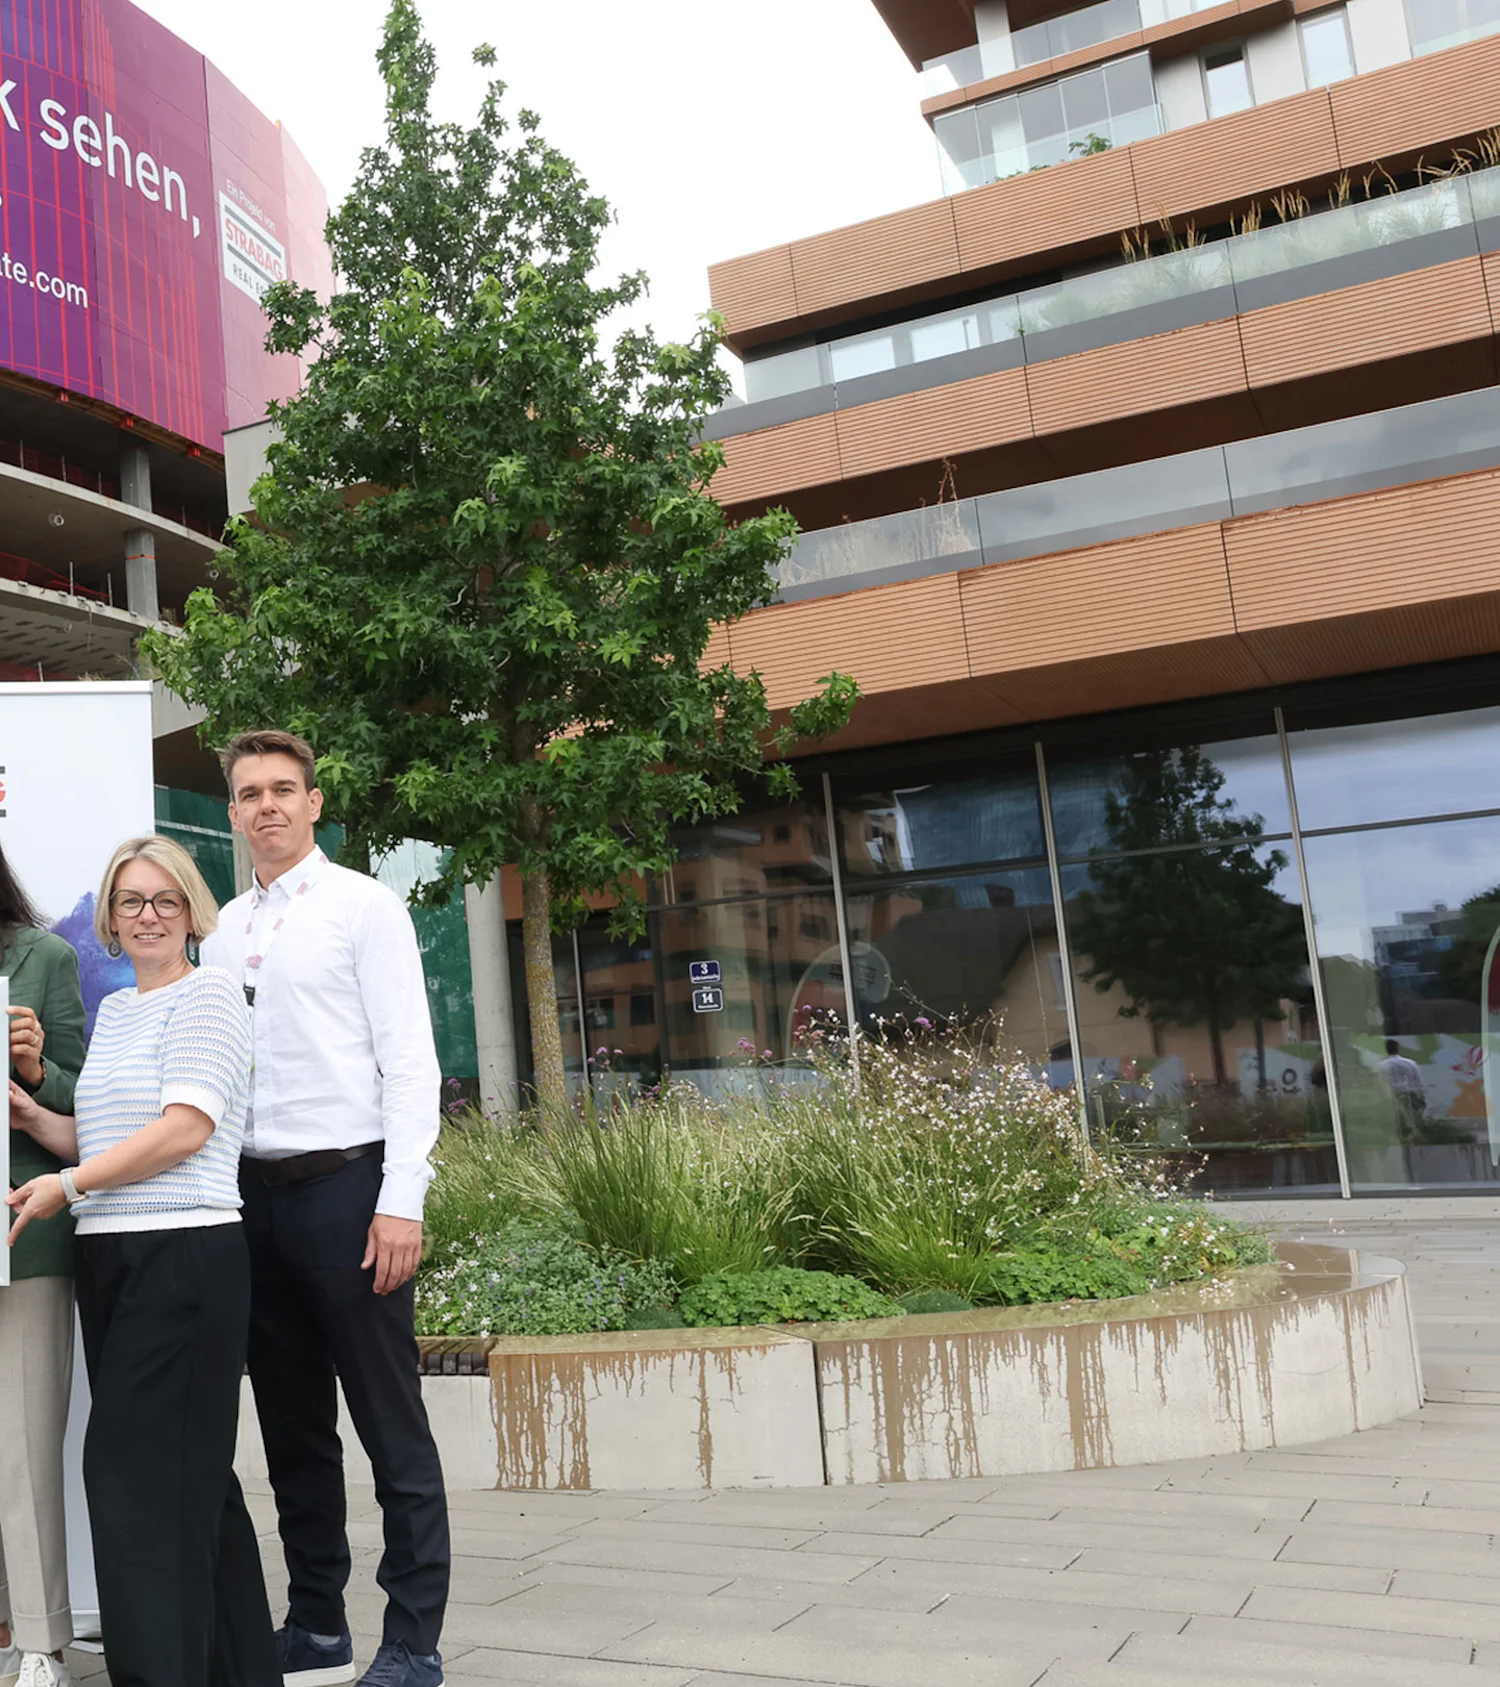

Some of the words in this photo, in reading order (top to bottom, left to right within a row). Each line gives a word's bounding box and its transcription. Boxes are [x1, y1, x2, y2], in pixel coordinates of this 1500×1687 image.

[40, 98, 201, 239] sehen,
[225, 217, 283, 281] STRABAG
[700, 963, 709, 975] 3
